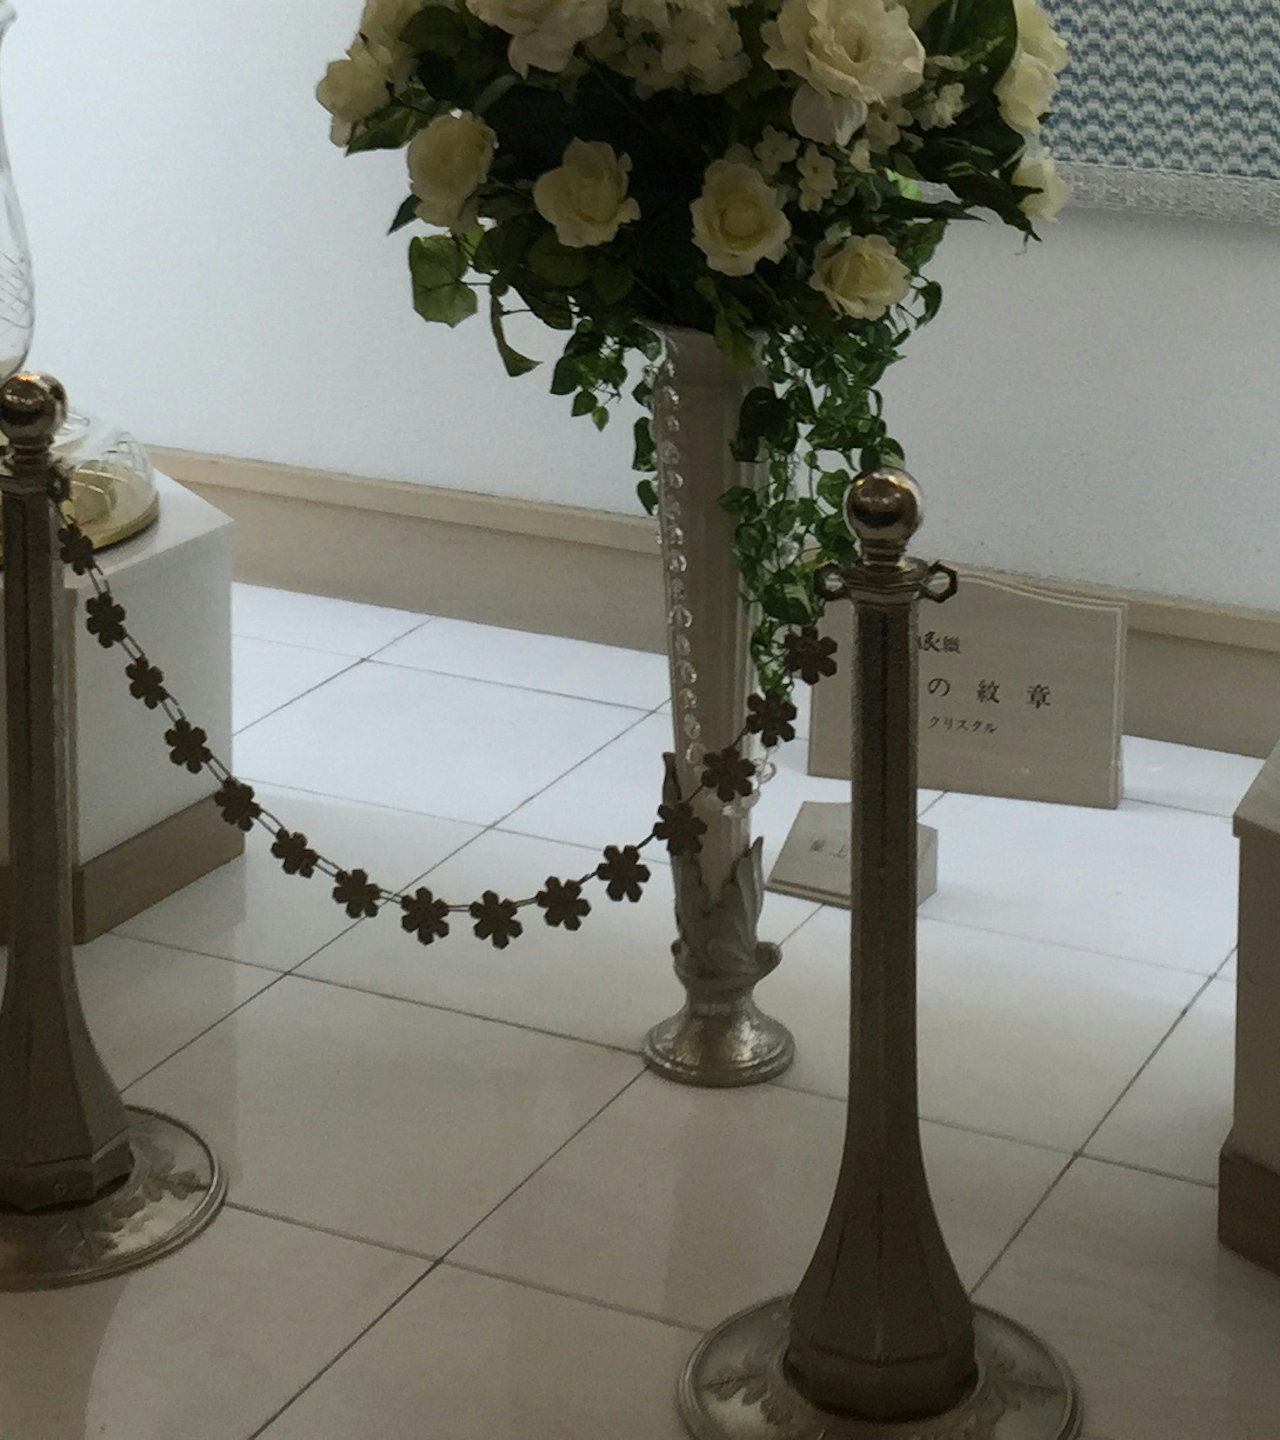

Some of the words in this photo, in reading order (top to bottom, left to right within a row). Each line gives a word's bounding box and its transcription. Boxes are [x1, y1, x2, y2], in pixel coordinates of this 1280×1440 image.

[928, 716, 998, 734] クリスタル
